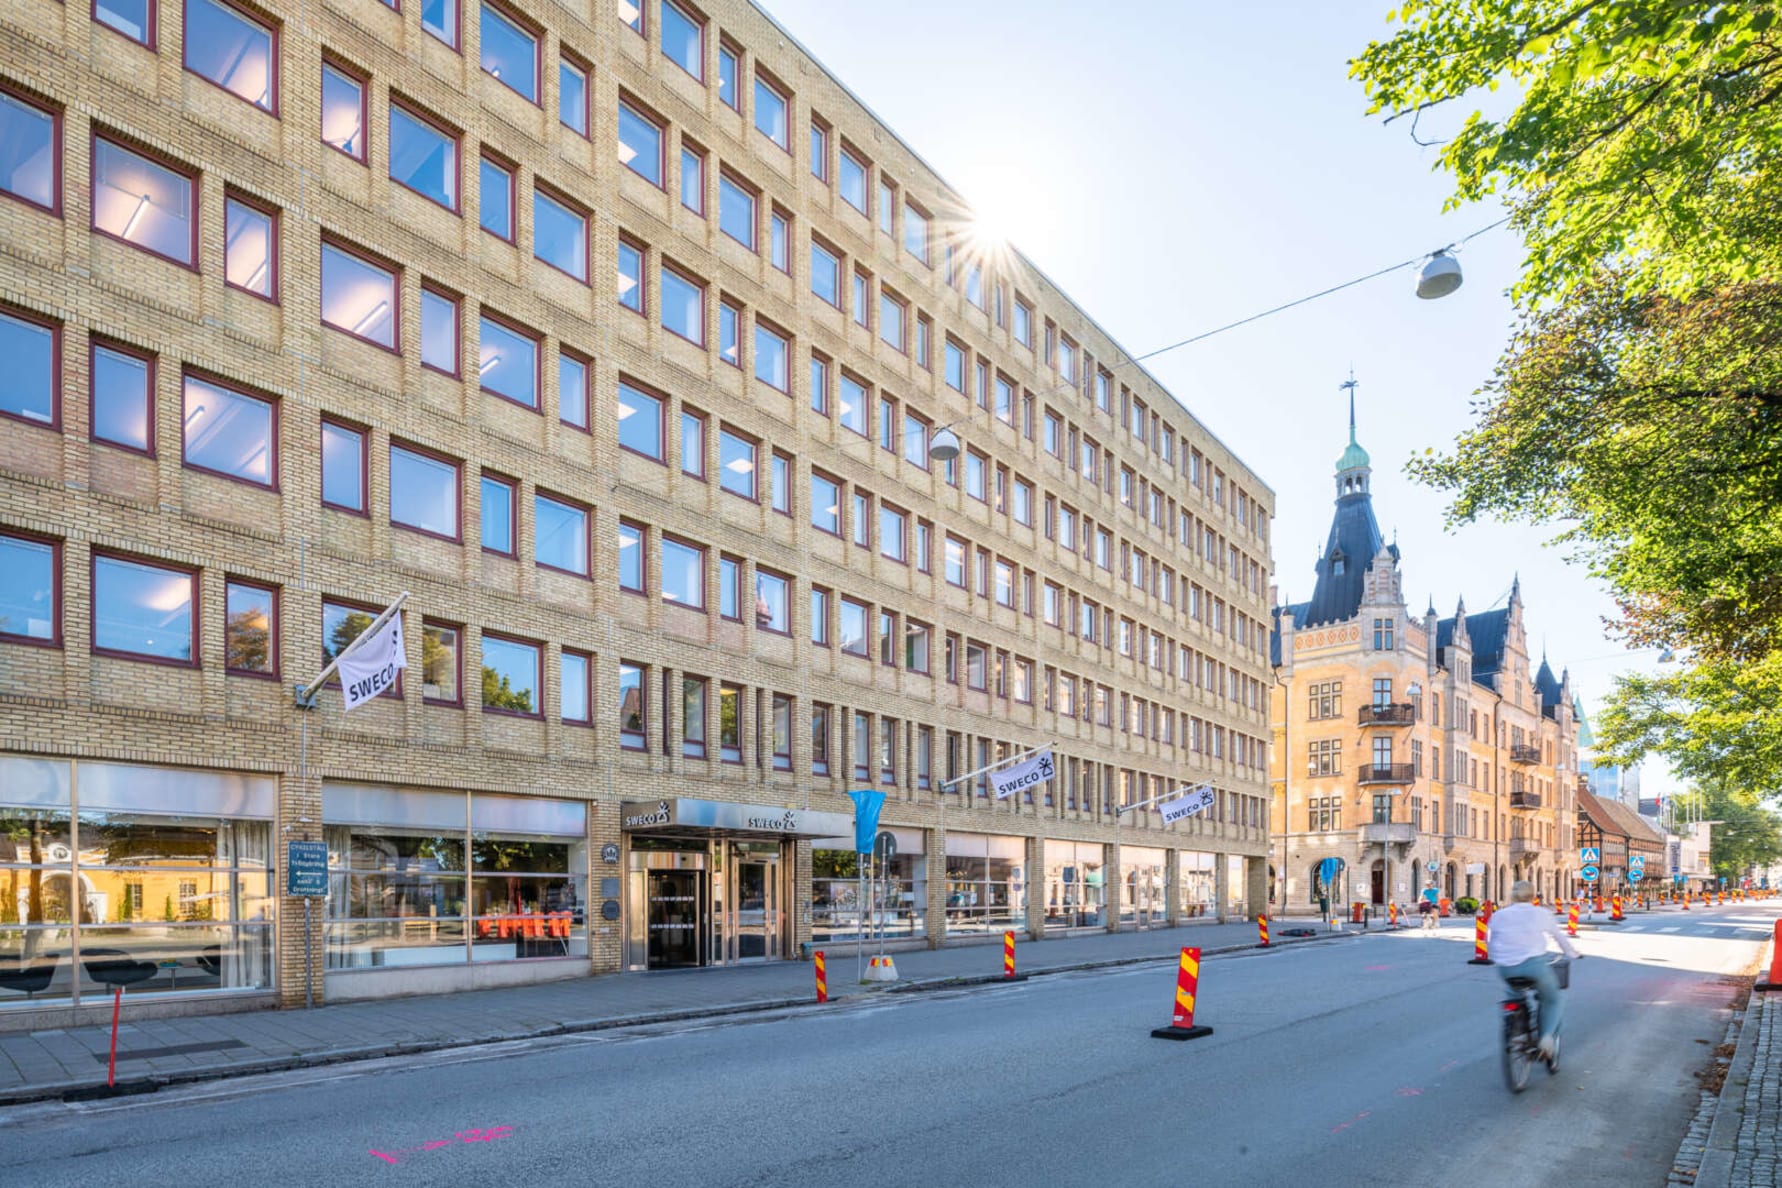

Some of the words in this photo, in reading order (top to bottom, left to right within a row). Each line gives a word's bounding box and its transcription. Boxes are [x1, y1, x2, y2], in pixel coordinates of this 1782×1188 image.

[349, 662, 394, 702] SWECO
[998, 772, 1039, 794] SWECO
[626, 814, 656, 826] SWECO
[1165, 803, 1200, 821] SWECO
[748, 817, 782, 829] SWECO
